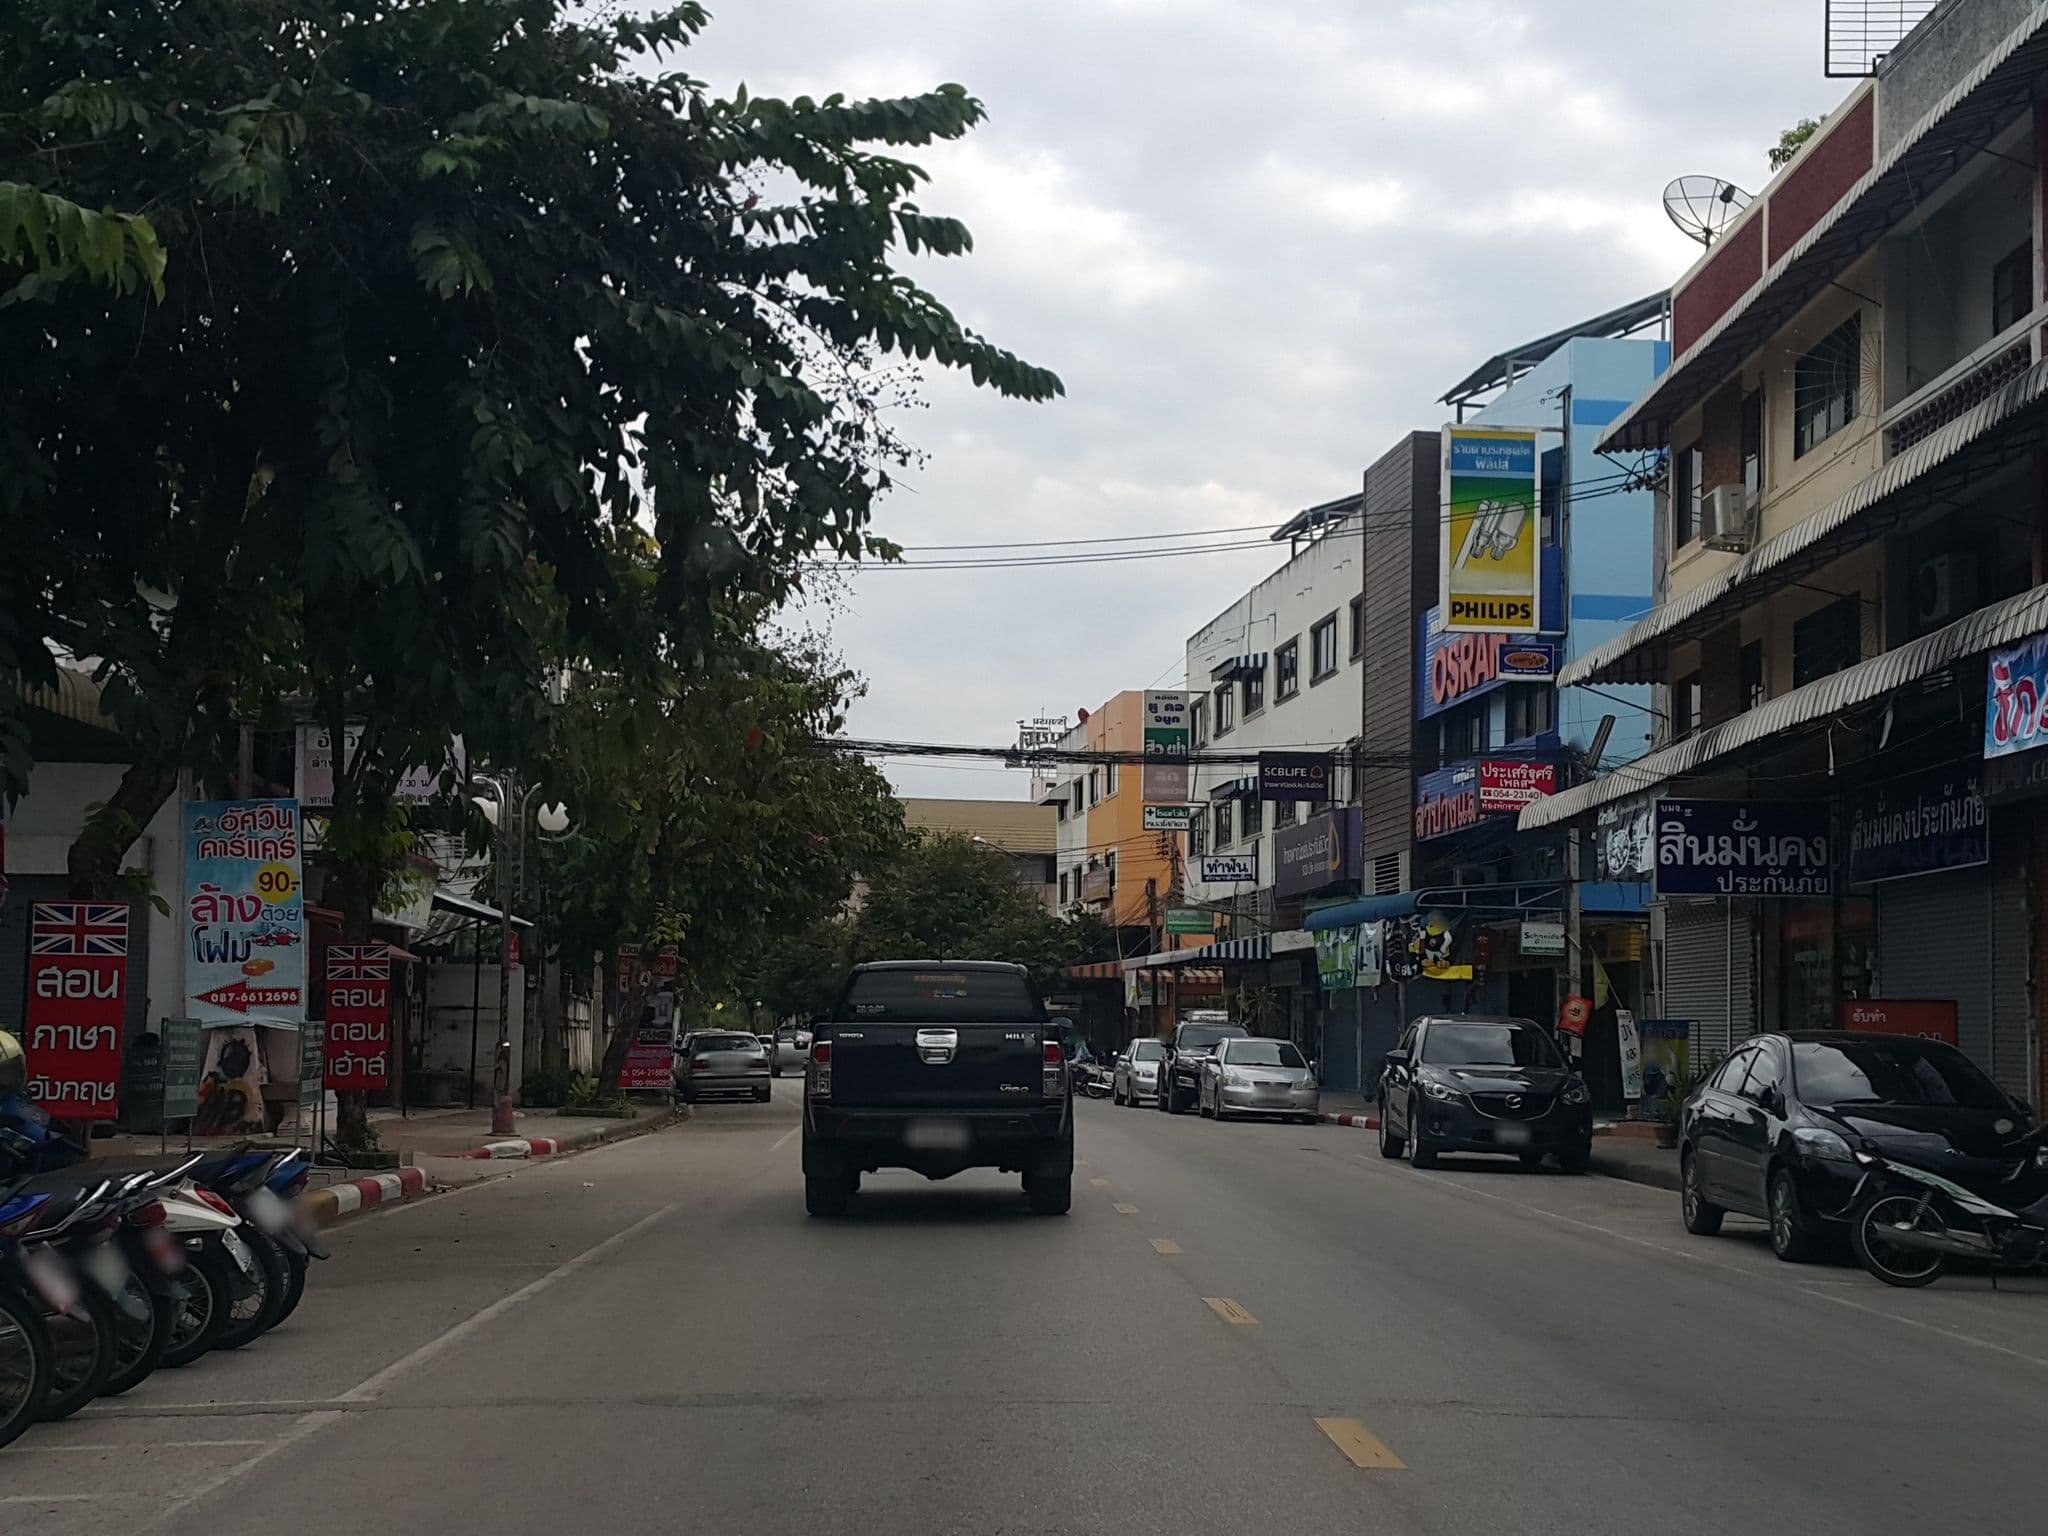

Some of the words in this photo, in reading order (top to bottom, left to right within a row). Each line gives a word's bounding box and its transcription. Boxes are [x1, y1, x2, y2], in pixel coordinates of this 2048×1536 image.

[1451, 601, 1531, 620] PHILIPS
[1264, 767, 1307, 777] SCBLIFE
[219, 804, 294, 833] อัศวิน
[1415, 789, 1476, 840] ลำปางแส
[1852, 776, 1985, 851] สินมั่นคงประกันภัย
[199, 832, 297, 860] คาร์แคร์
[1660, 807, 1828, 867] สินมั่นคง
[1206, 858, 1249, 873] ทำฟัน
[1716, 867, 1828, 893] ประกันภัย
[191, 883, 262, 924] ล้าง
[261, 904, 300, 922] ด้วย
[193, 925, 251, 964] โฟม
[36, 965, 119, 999] สอน
[210, 991, 298, 1005] 087-6612696
[32, 1023, 116, 1051] ภาษา
[838, 1032, 864, 1040] TOYOTA
[27, 1073, 116, 1106] อังกฤษ
